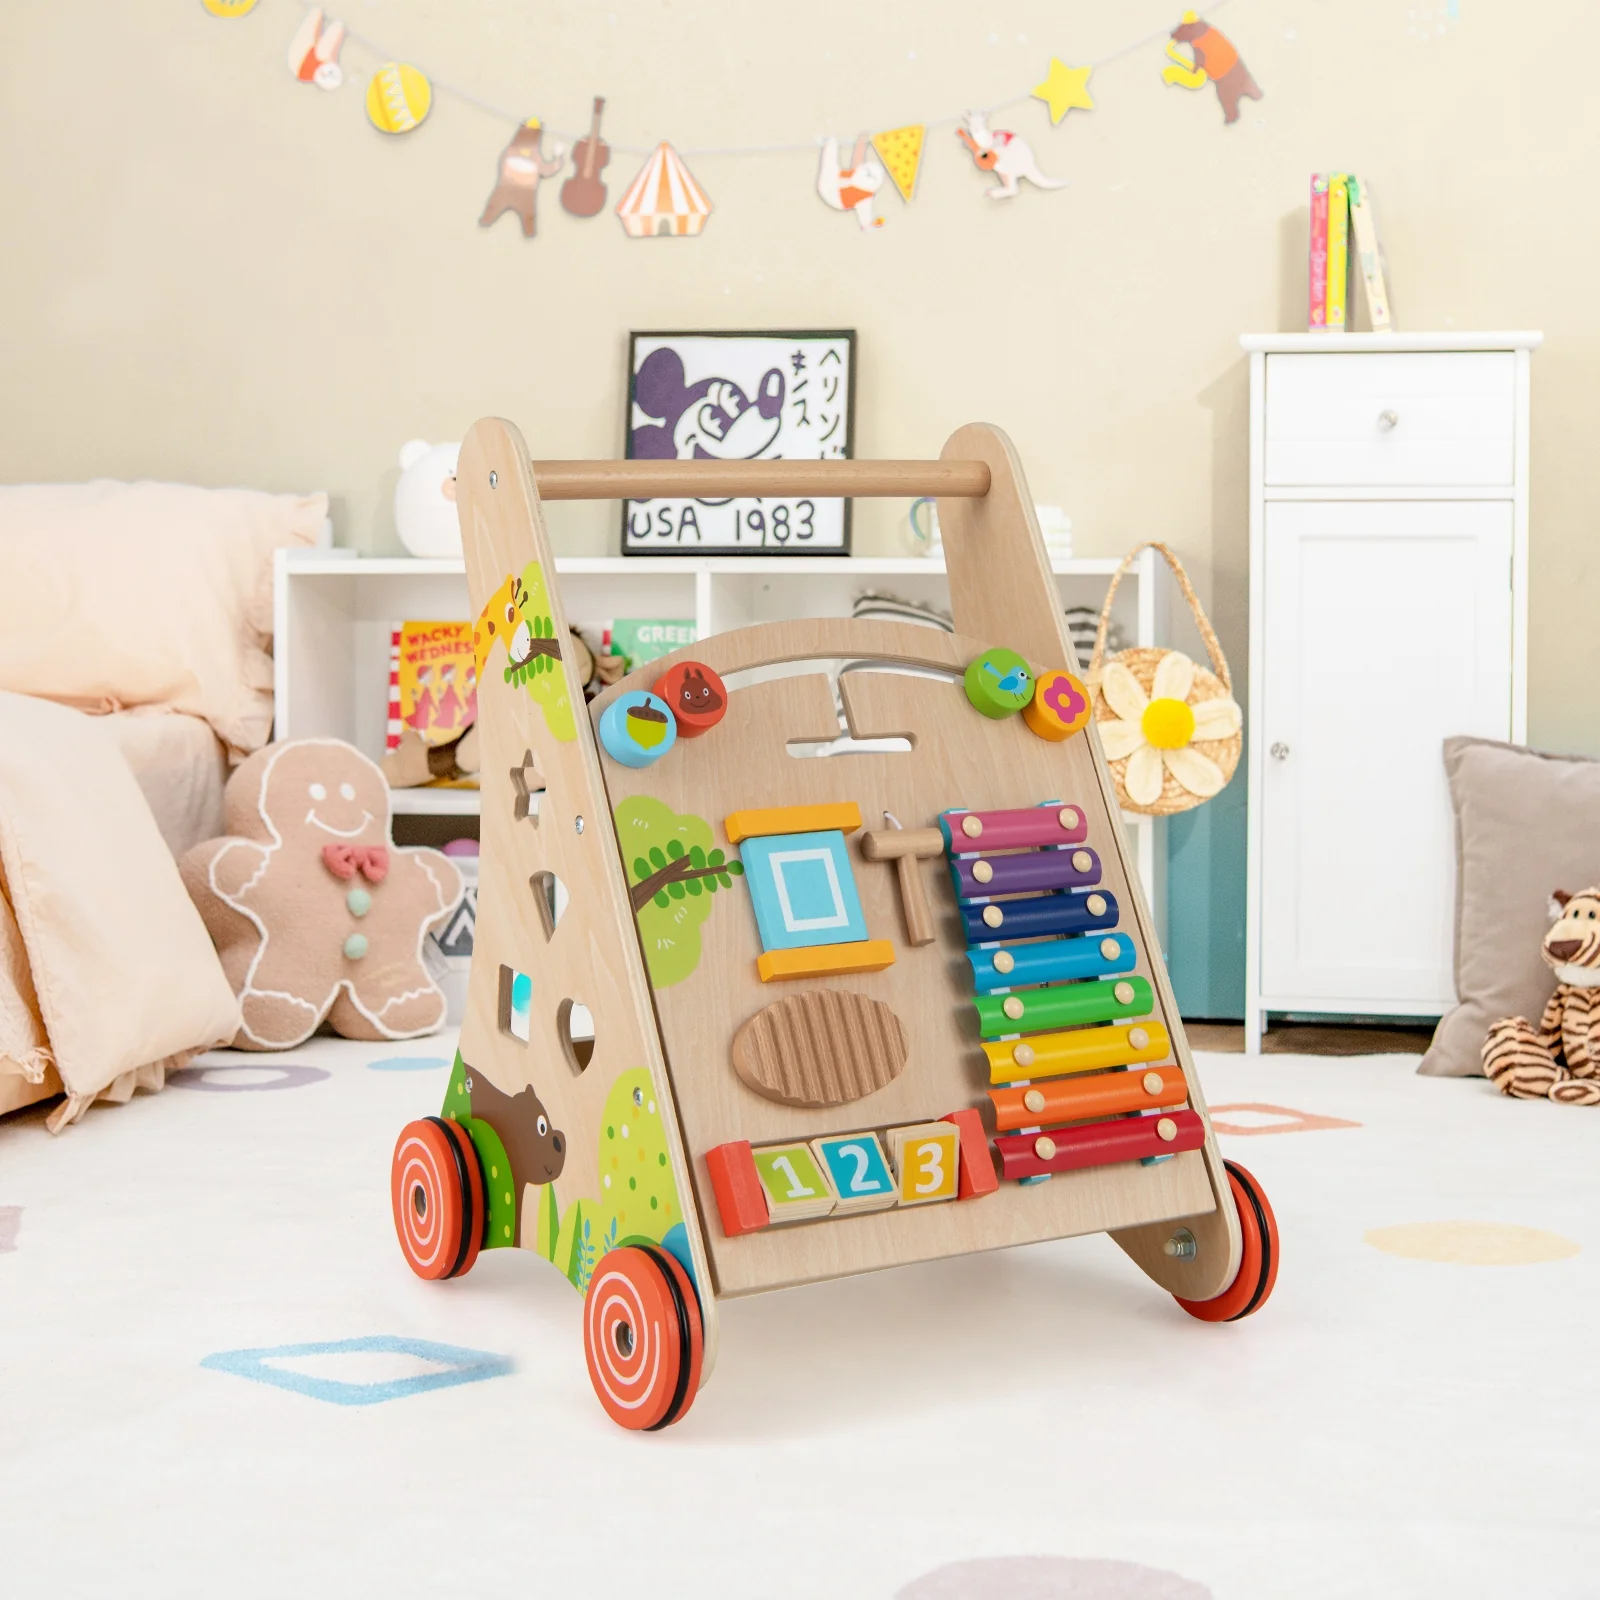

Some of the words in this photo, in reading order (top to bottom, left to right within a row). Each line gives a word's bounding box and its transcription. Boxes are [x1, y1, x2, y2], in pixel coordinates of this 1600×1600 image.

[630, 505, 701, 541] USA
[736, 500, 815, 546] 1983
[406, 626, 465, 646] WACKY
[771, 1155, 815, 1198] 1
[838, 1144, 881, 1192] 2
[915, 1142, 944, 1193] 3
